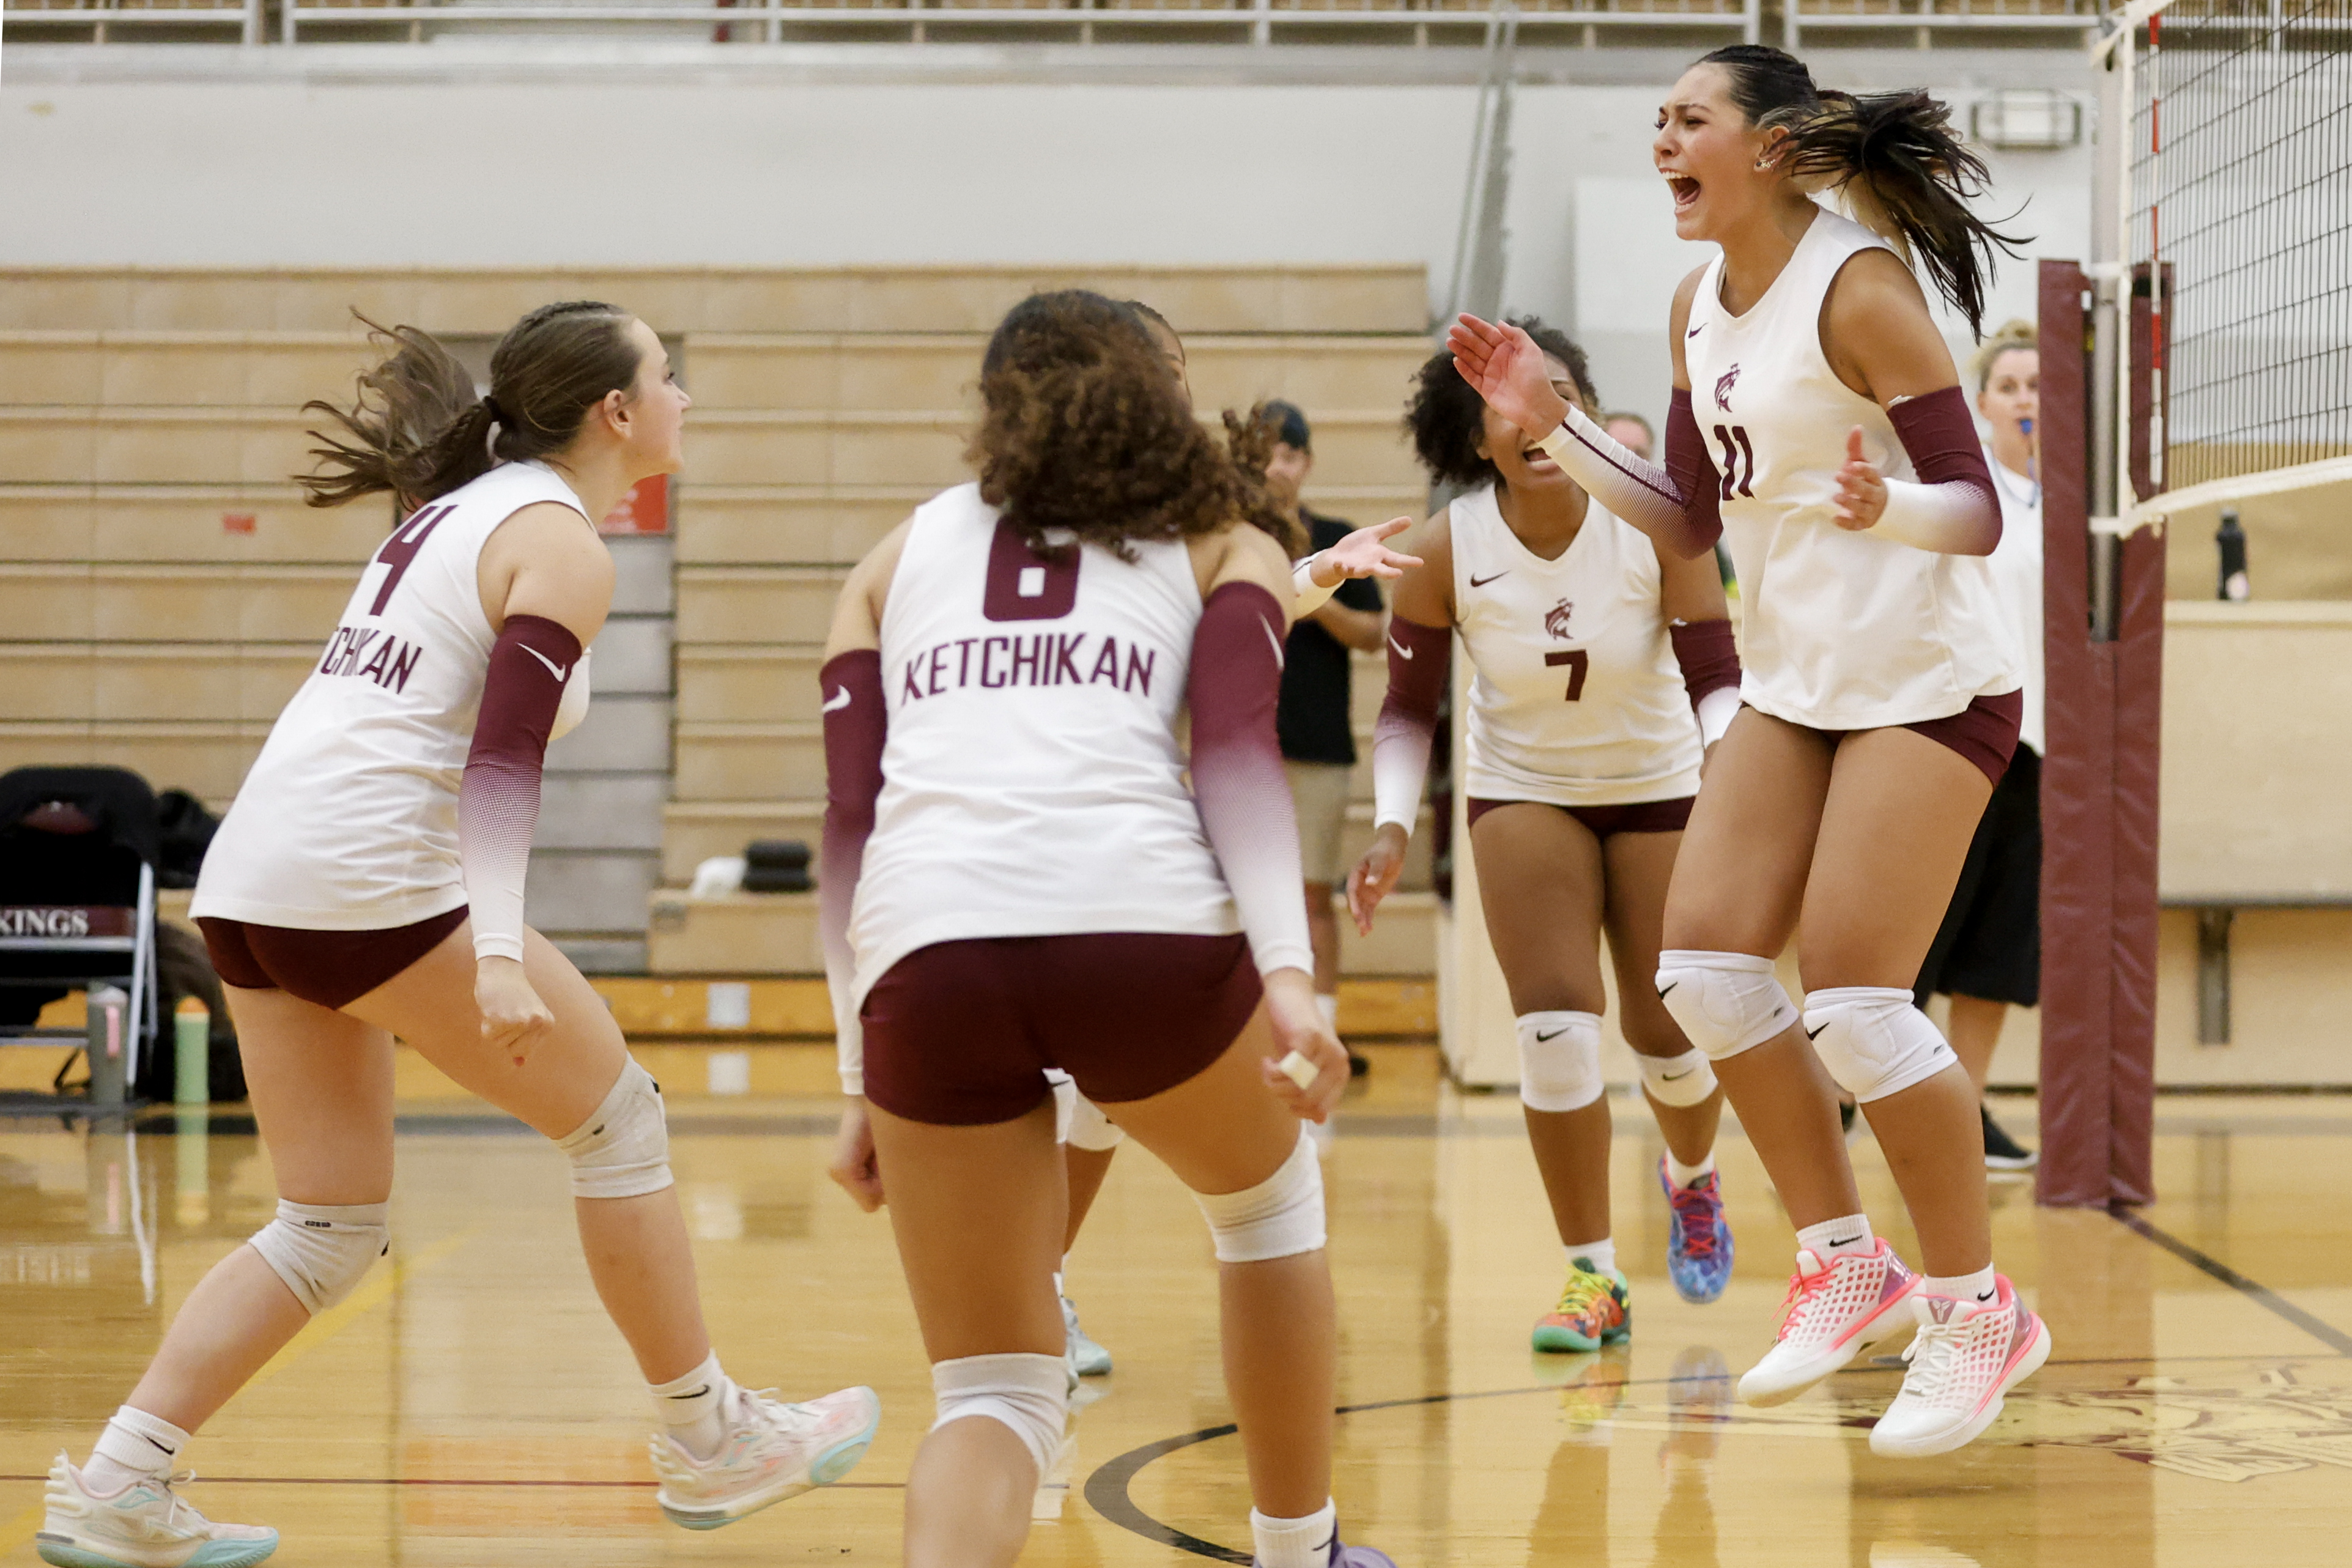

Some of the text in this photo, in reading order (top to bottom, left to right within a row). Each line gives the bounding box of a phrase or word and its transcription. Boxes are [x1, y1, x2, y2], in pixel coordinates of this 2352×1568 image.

[1713, 424, 1756, 501] 11
[369, 505, 459, 616] 4
[902, 632, 1156, 705] KETCHIKAN
[1545, 649, 1589, 702] 7
